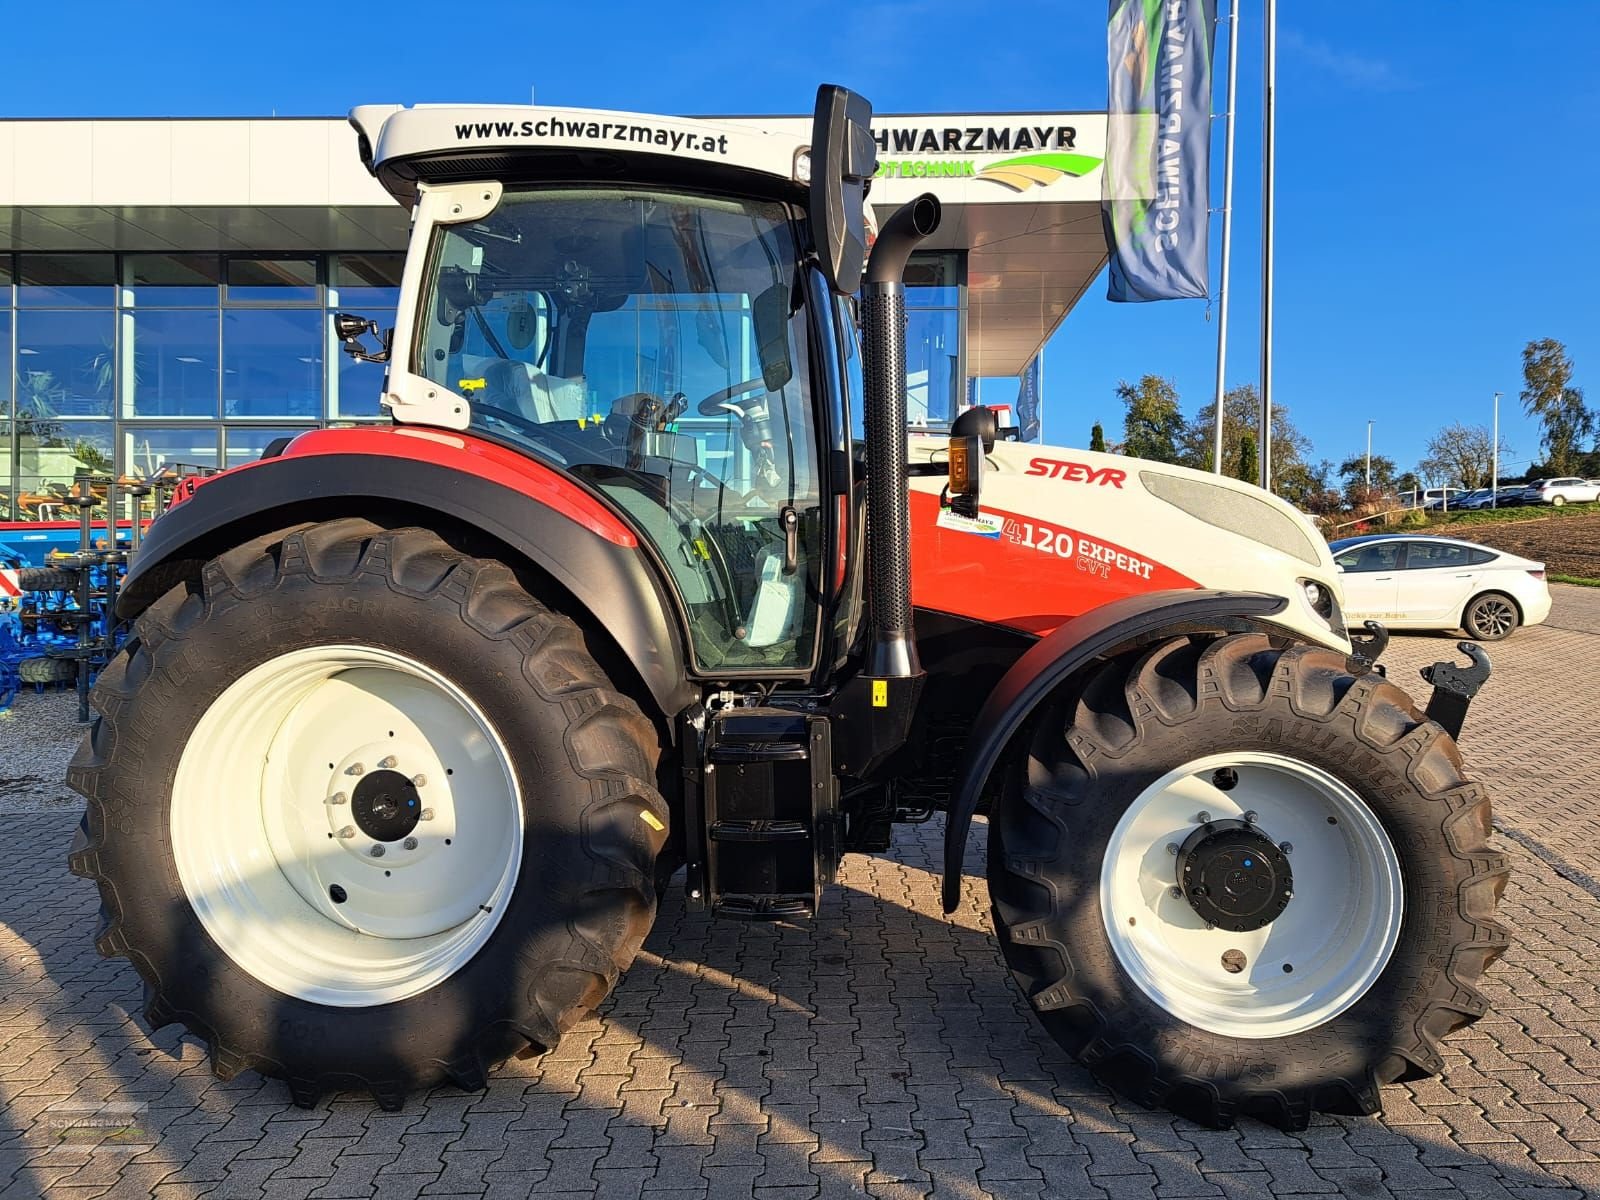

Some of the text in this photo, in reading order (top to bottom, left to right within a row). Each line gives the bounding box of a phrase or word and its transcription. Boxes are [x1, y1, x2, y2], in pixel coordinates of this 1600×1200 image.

[455, 117, 728, 154] www.schwarzmayr.at
[871, 126, 1076, 150] HWARZMAYR
[876, 160, 976, 178] DTECHNIK
[1024, 457, 1127, 489] STEYR
[1001, 518, 1154, 579] 4120 EXPERT
[1076, 555, 1111, 579] CVT
